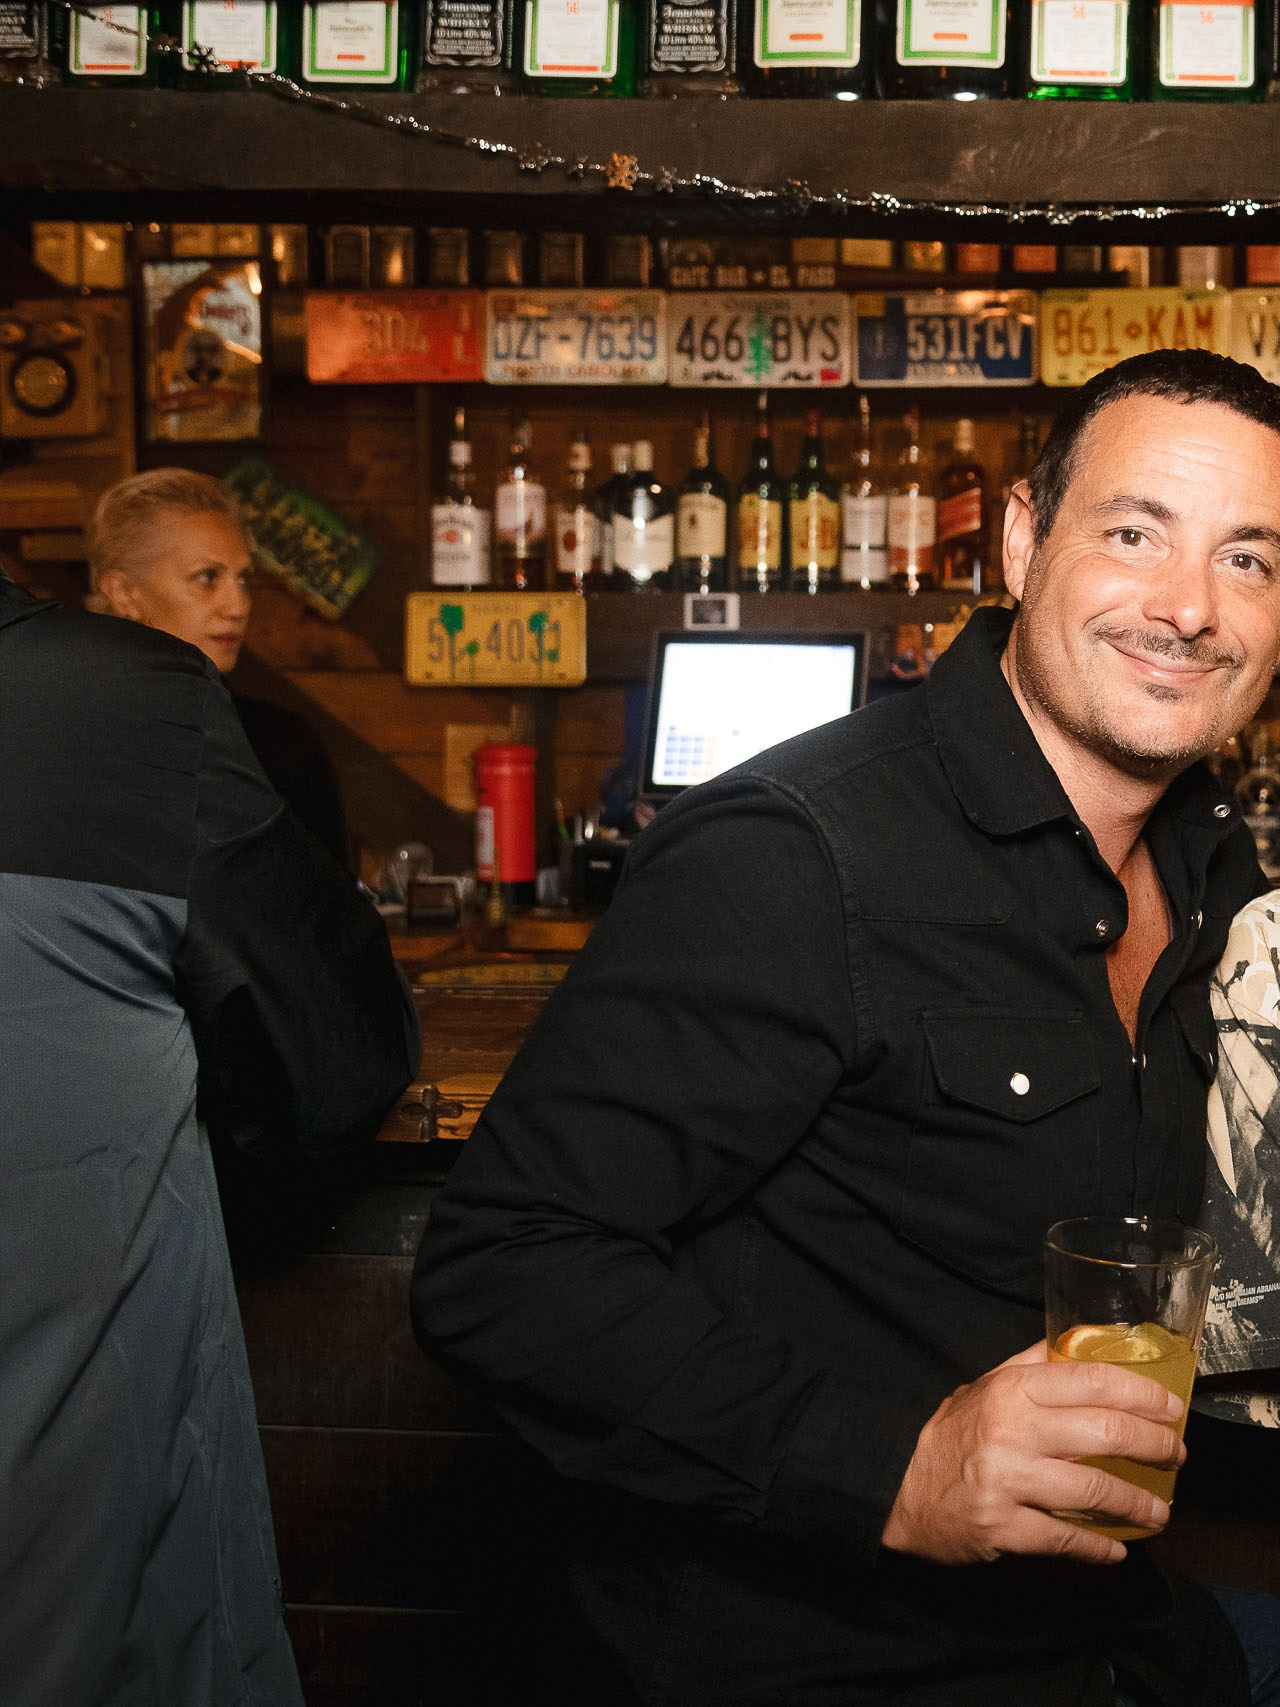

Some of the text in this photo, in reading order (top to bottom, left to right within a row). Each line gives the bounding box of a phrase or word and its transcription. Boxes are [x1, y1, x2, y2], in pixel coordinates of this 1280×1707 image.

[675, 314, 841, 363] 466 BYS
[907, 317, 1025, 361] 531FCV
[1053, 305, 1215, 357] 861 KAM
